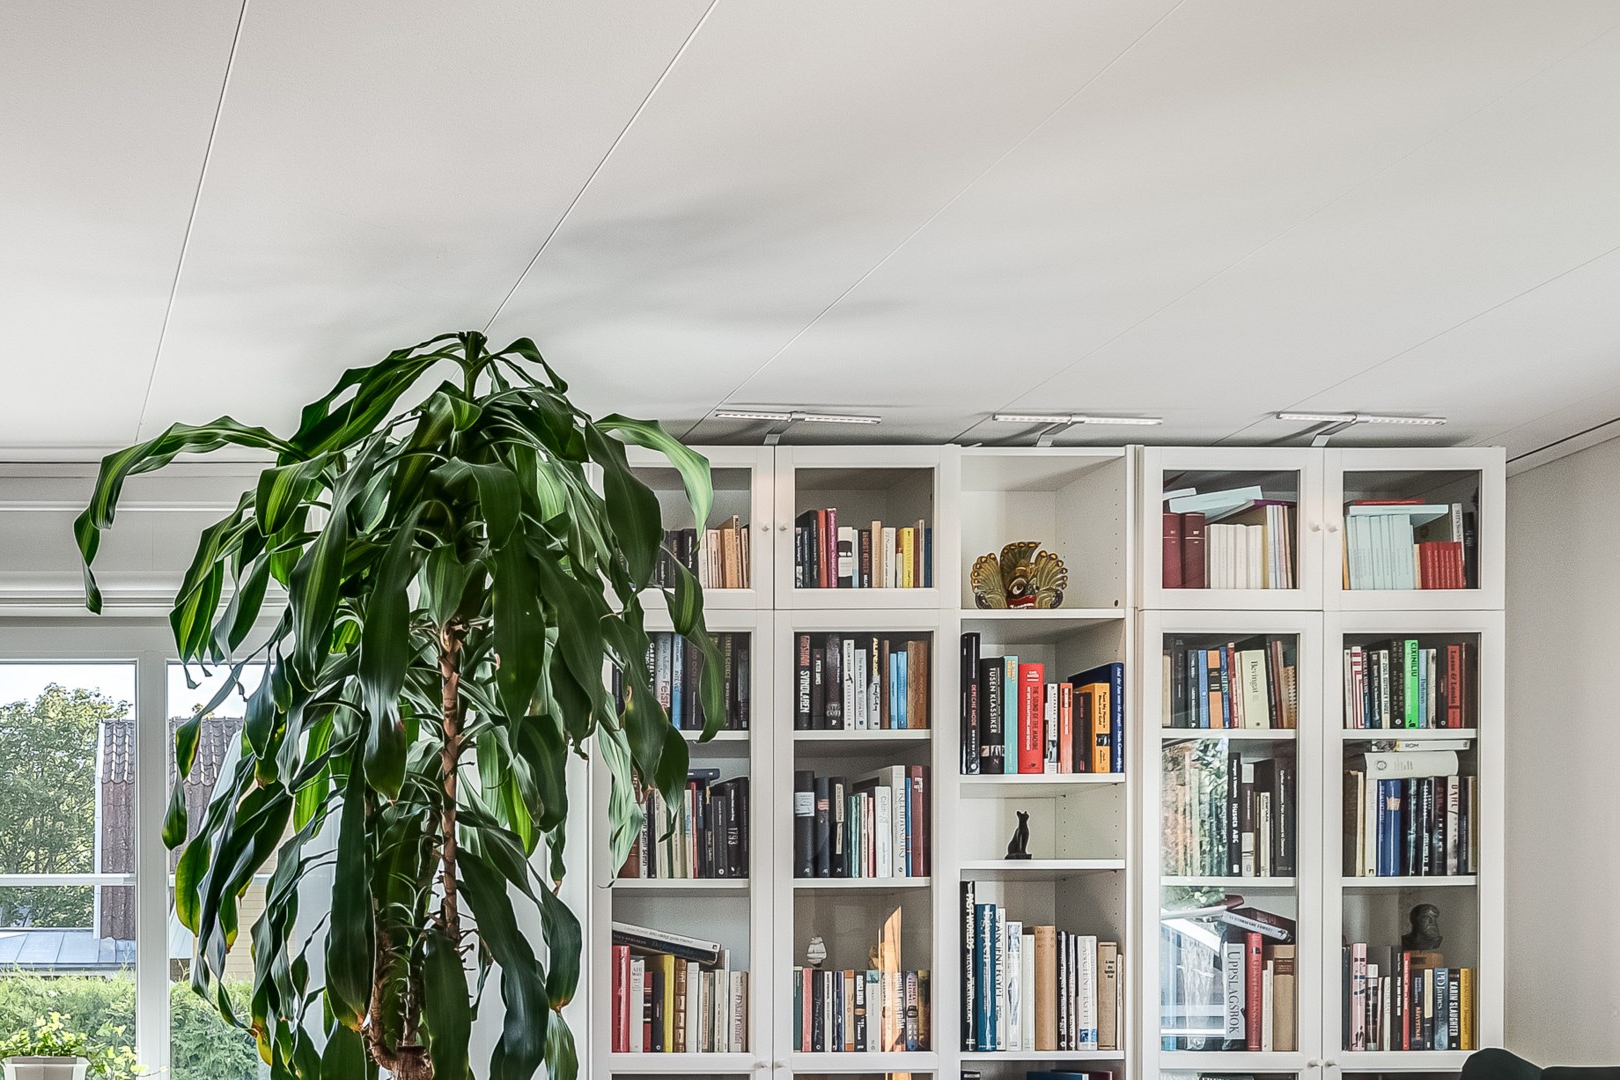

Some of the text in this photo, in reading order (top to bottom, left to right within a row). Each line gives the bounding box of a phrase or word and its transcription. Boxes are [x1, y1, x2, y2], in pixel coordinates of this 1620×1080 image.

[724, 658, 732, 679] GEORGE
[1250, 660, 1259, 694] Bevingat
[1410, 664, 1418, 677] LIU
[660, 680, 670, 709] Felste
[800, 670, 810, 714] SVINDLAREN
[989, 667, 997, 733] TUSEN KLASSIKER
[727, 827, 738, 845] 1793
[996, 925, 1004, 998] ANCIENT EGYPT
[1082, 946, 1090, 991] ANCIENT
[1228, 951, 1241, 1034] UPPSLAGSBOK
[1436, 986, 1446, 1010] James
[1449, 982, 1458, 1036] KARIN SLAUGHTER
